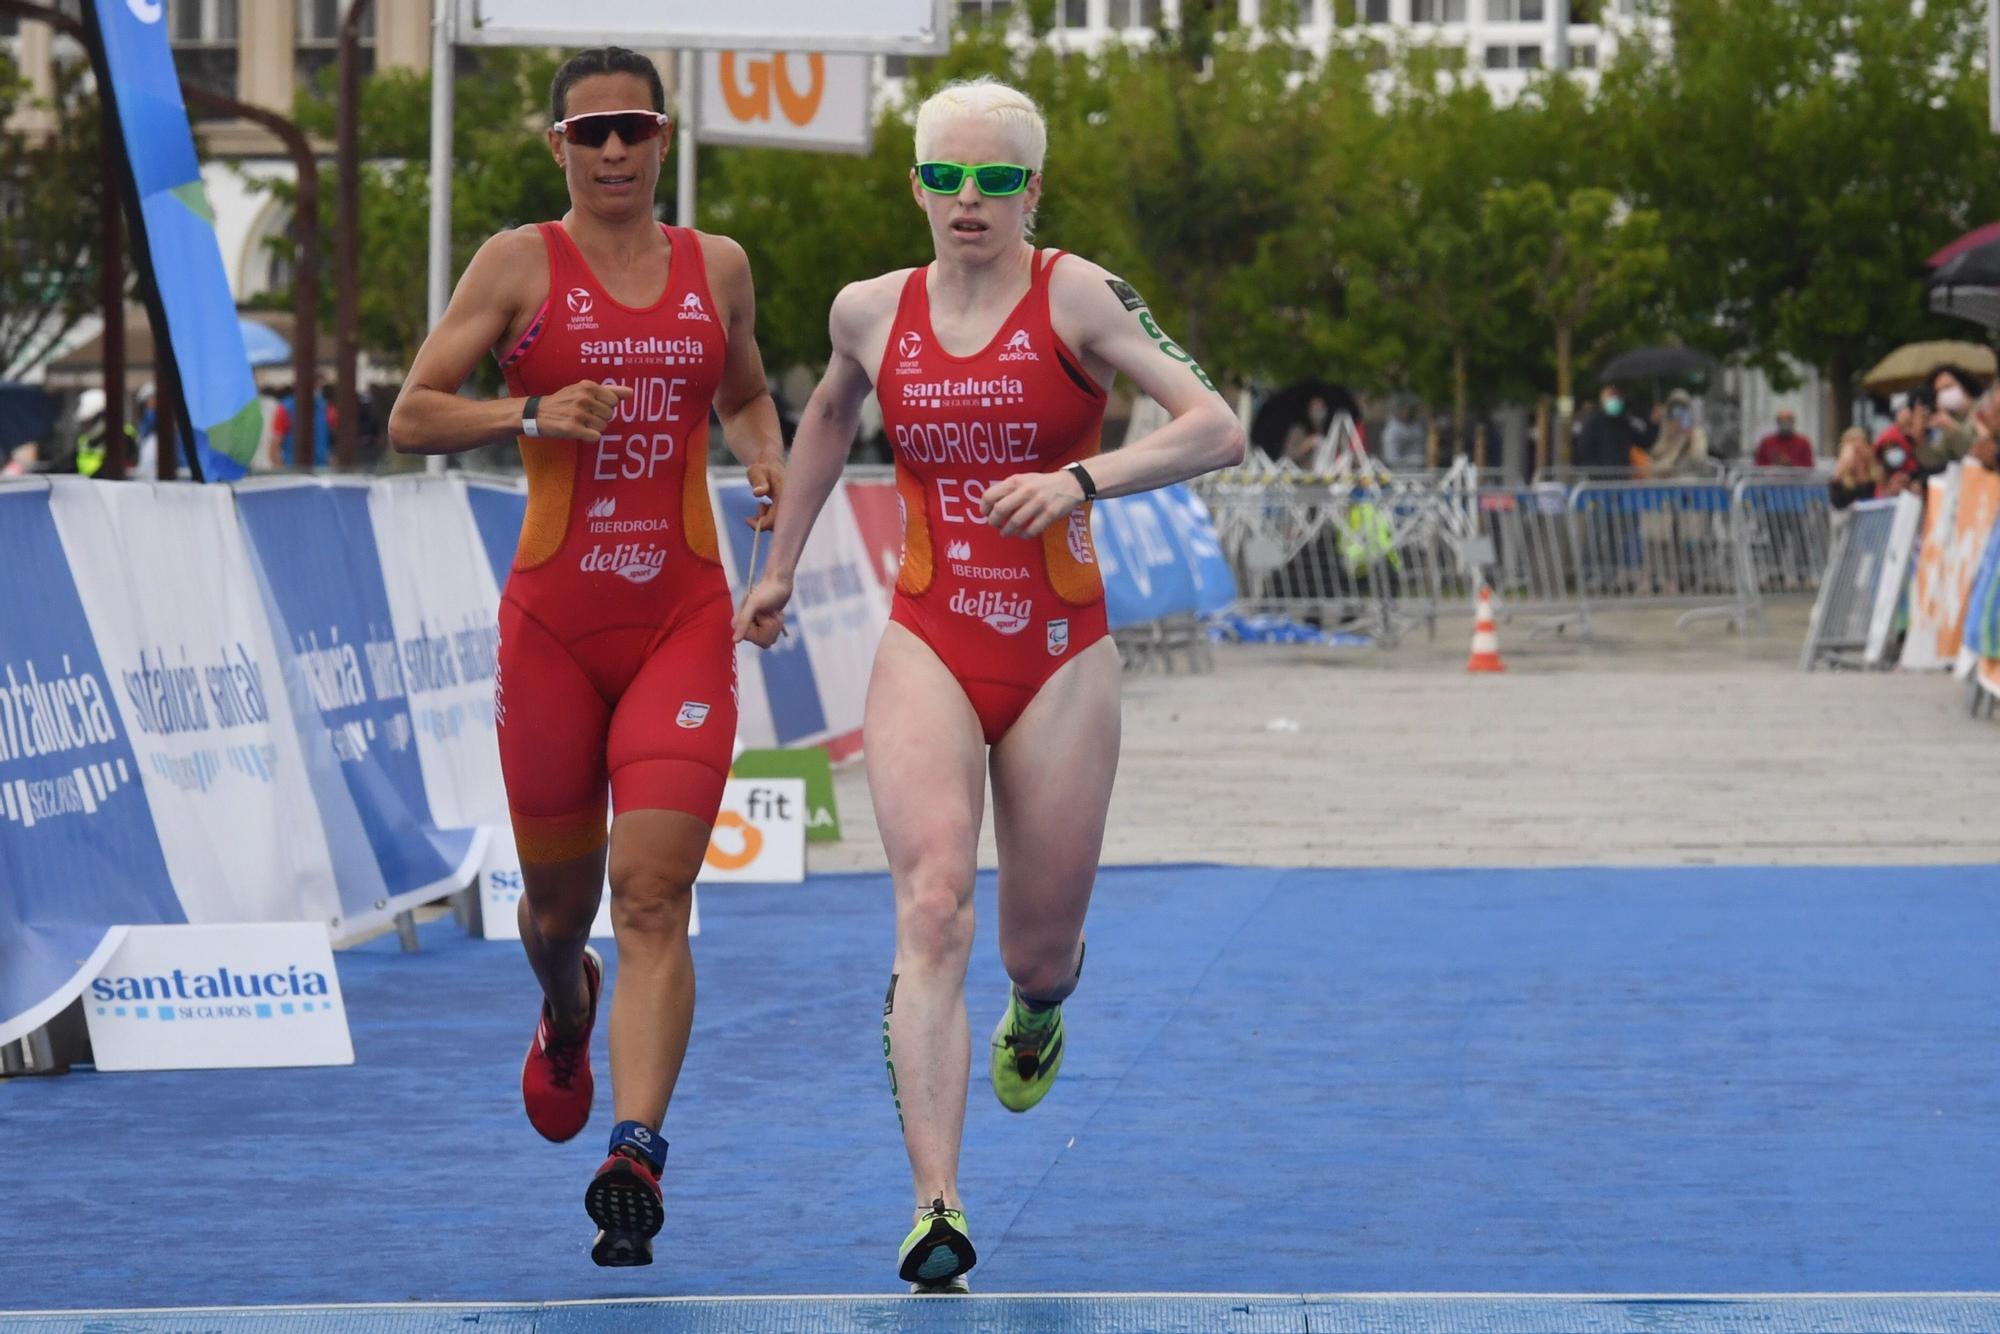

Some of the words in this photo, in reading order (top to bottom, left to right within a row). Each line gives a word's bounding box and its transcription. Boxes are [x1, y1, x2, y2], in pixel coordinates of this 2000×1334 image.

[719, 50, 824, 127] GO
[566, 322, 599, 331] Triathlon
[571, 315, 594, 323] World
[580, 336, 704, 356] santalucía
[903, 375, 1024, 398] santalucía
[594, 433, 674, 481] ESP
[895, 421, 1040, 464] RODRIGUEZ
[936, 478, 1004, 525] ES
[590, 519, 669, 534] IBERDROLA
[579, 542, 667, 573] delikia
[951, 563, 1031, 580] IBERDROLA
[949, 588, 1032, 619] delikia
[747, 788, 791, 820] fit
[91, 965, 329, 1002] santalucía
[178, 1004, 252, 1020] SEGUROS
